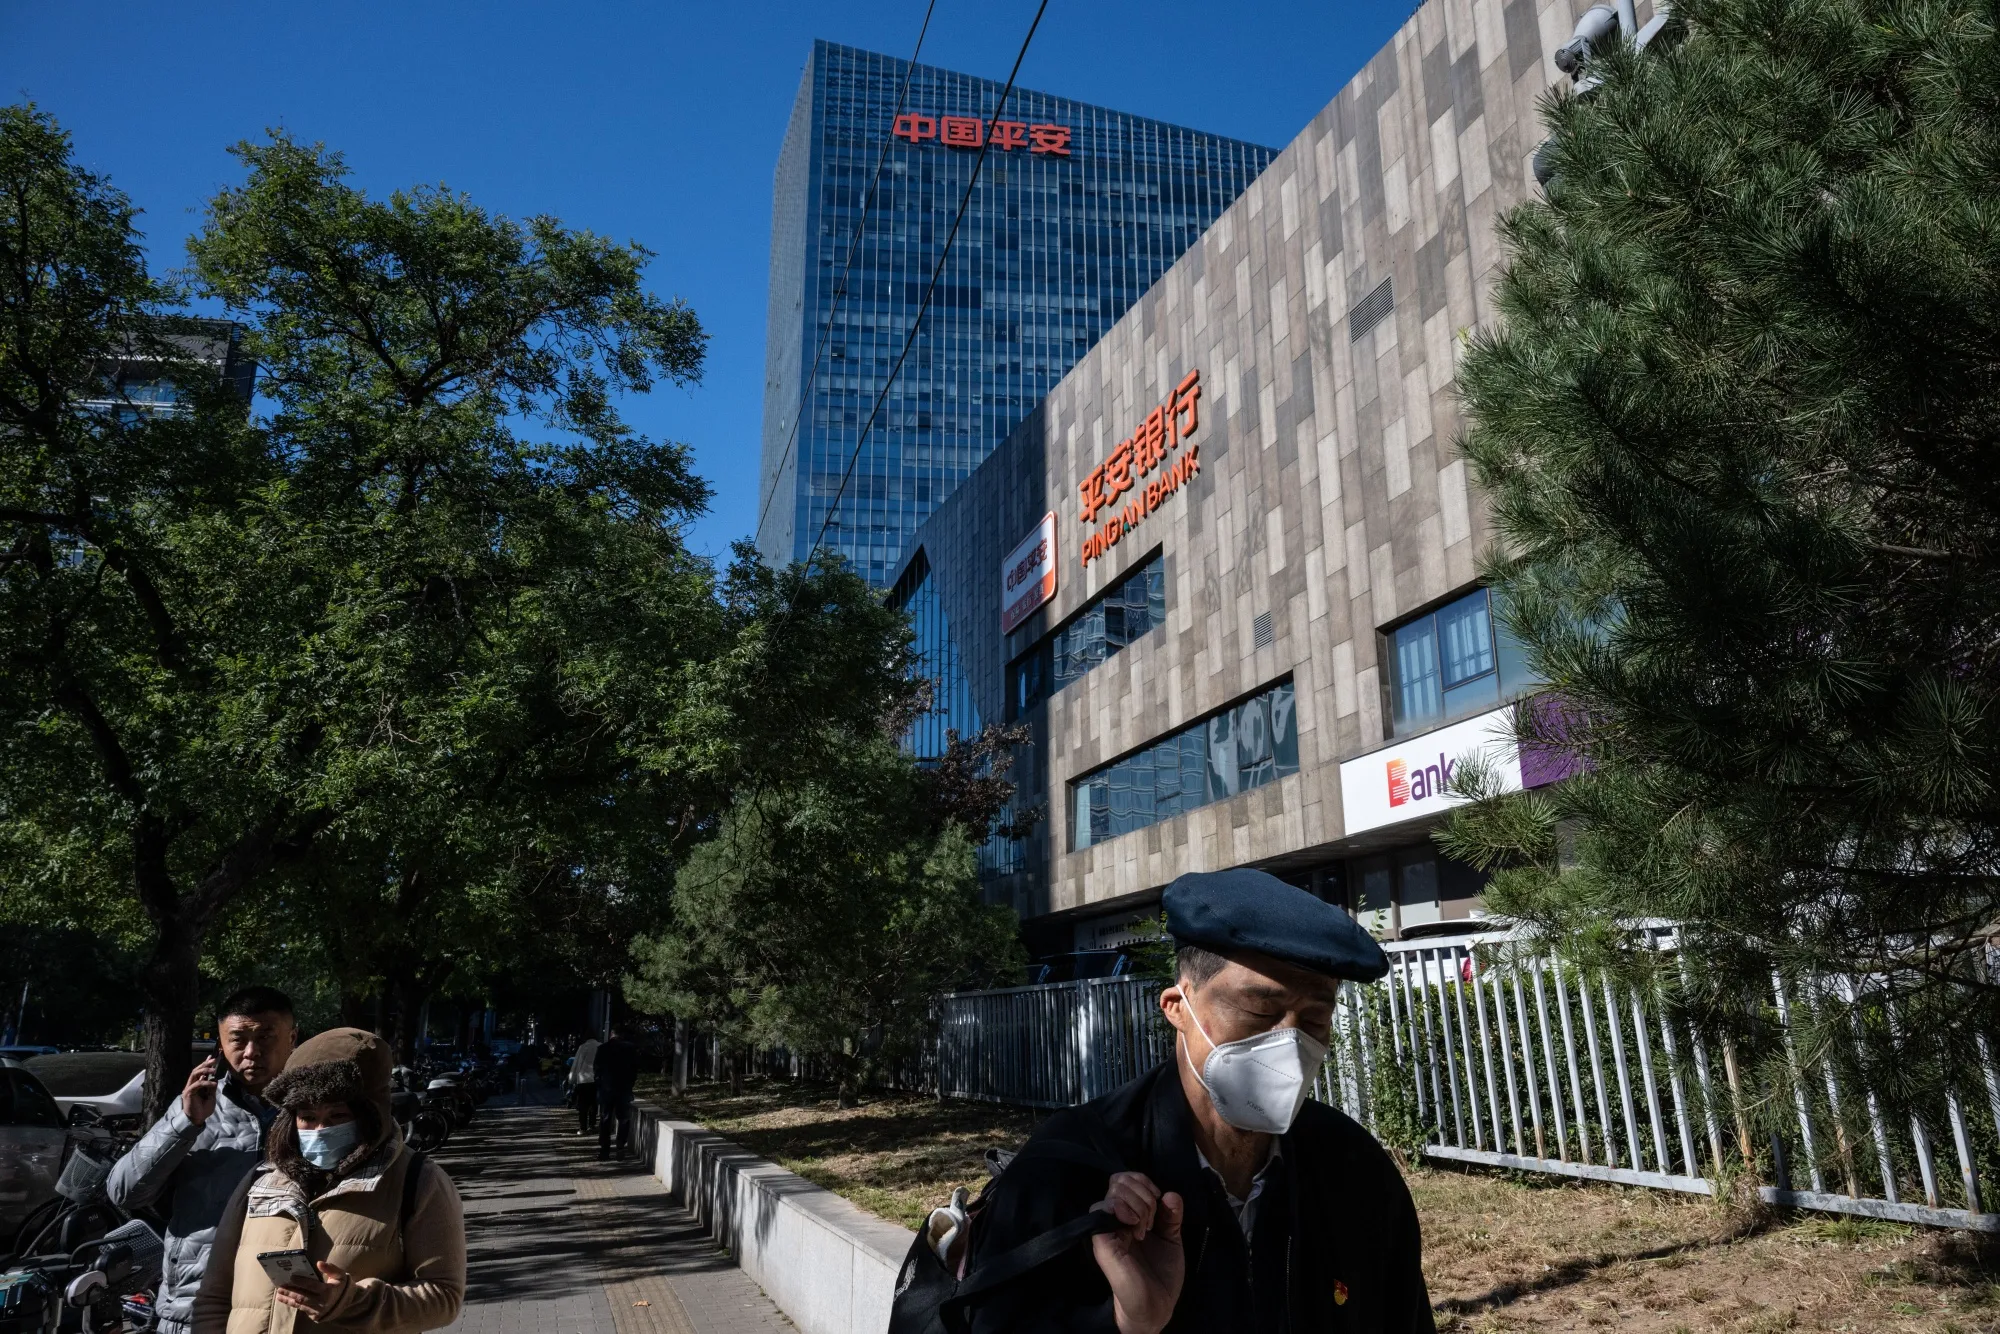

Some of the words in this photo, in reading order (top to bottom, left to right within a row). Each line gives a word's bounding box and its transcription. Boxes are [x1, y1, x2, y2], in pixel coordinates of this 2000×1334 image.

[893, 112, 1071, 155] 中国平安
[1080, 369, 1201, 523] 平安银行
[1147, 444, 1200, 513] BANK
[1007, 537, 1048, 592] 中国平安
[1386, 752, 1458, 808] Bank
